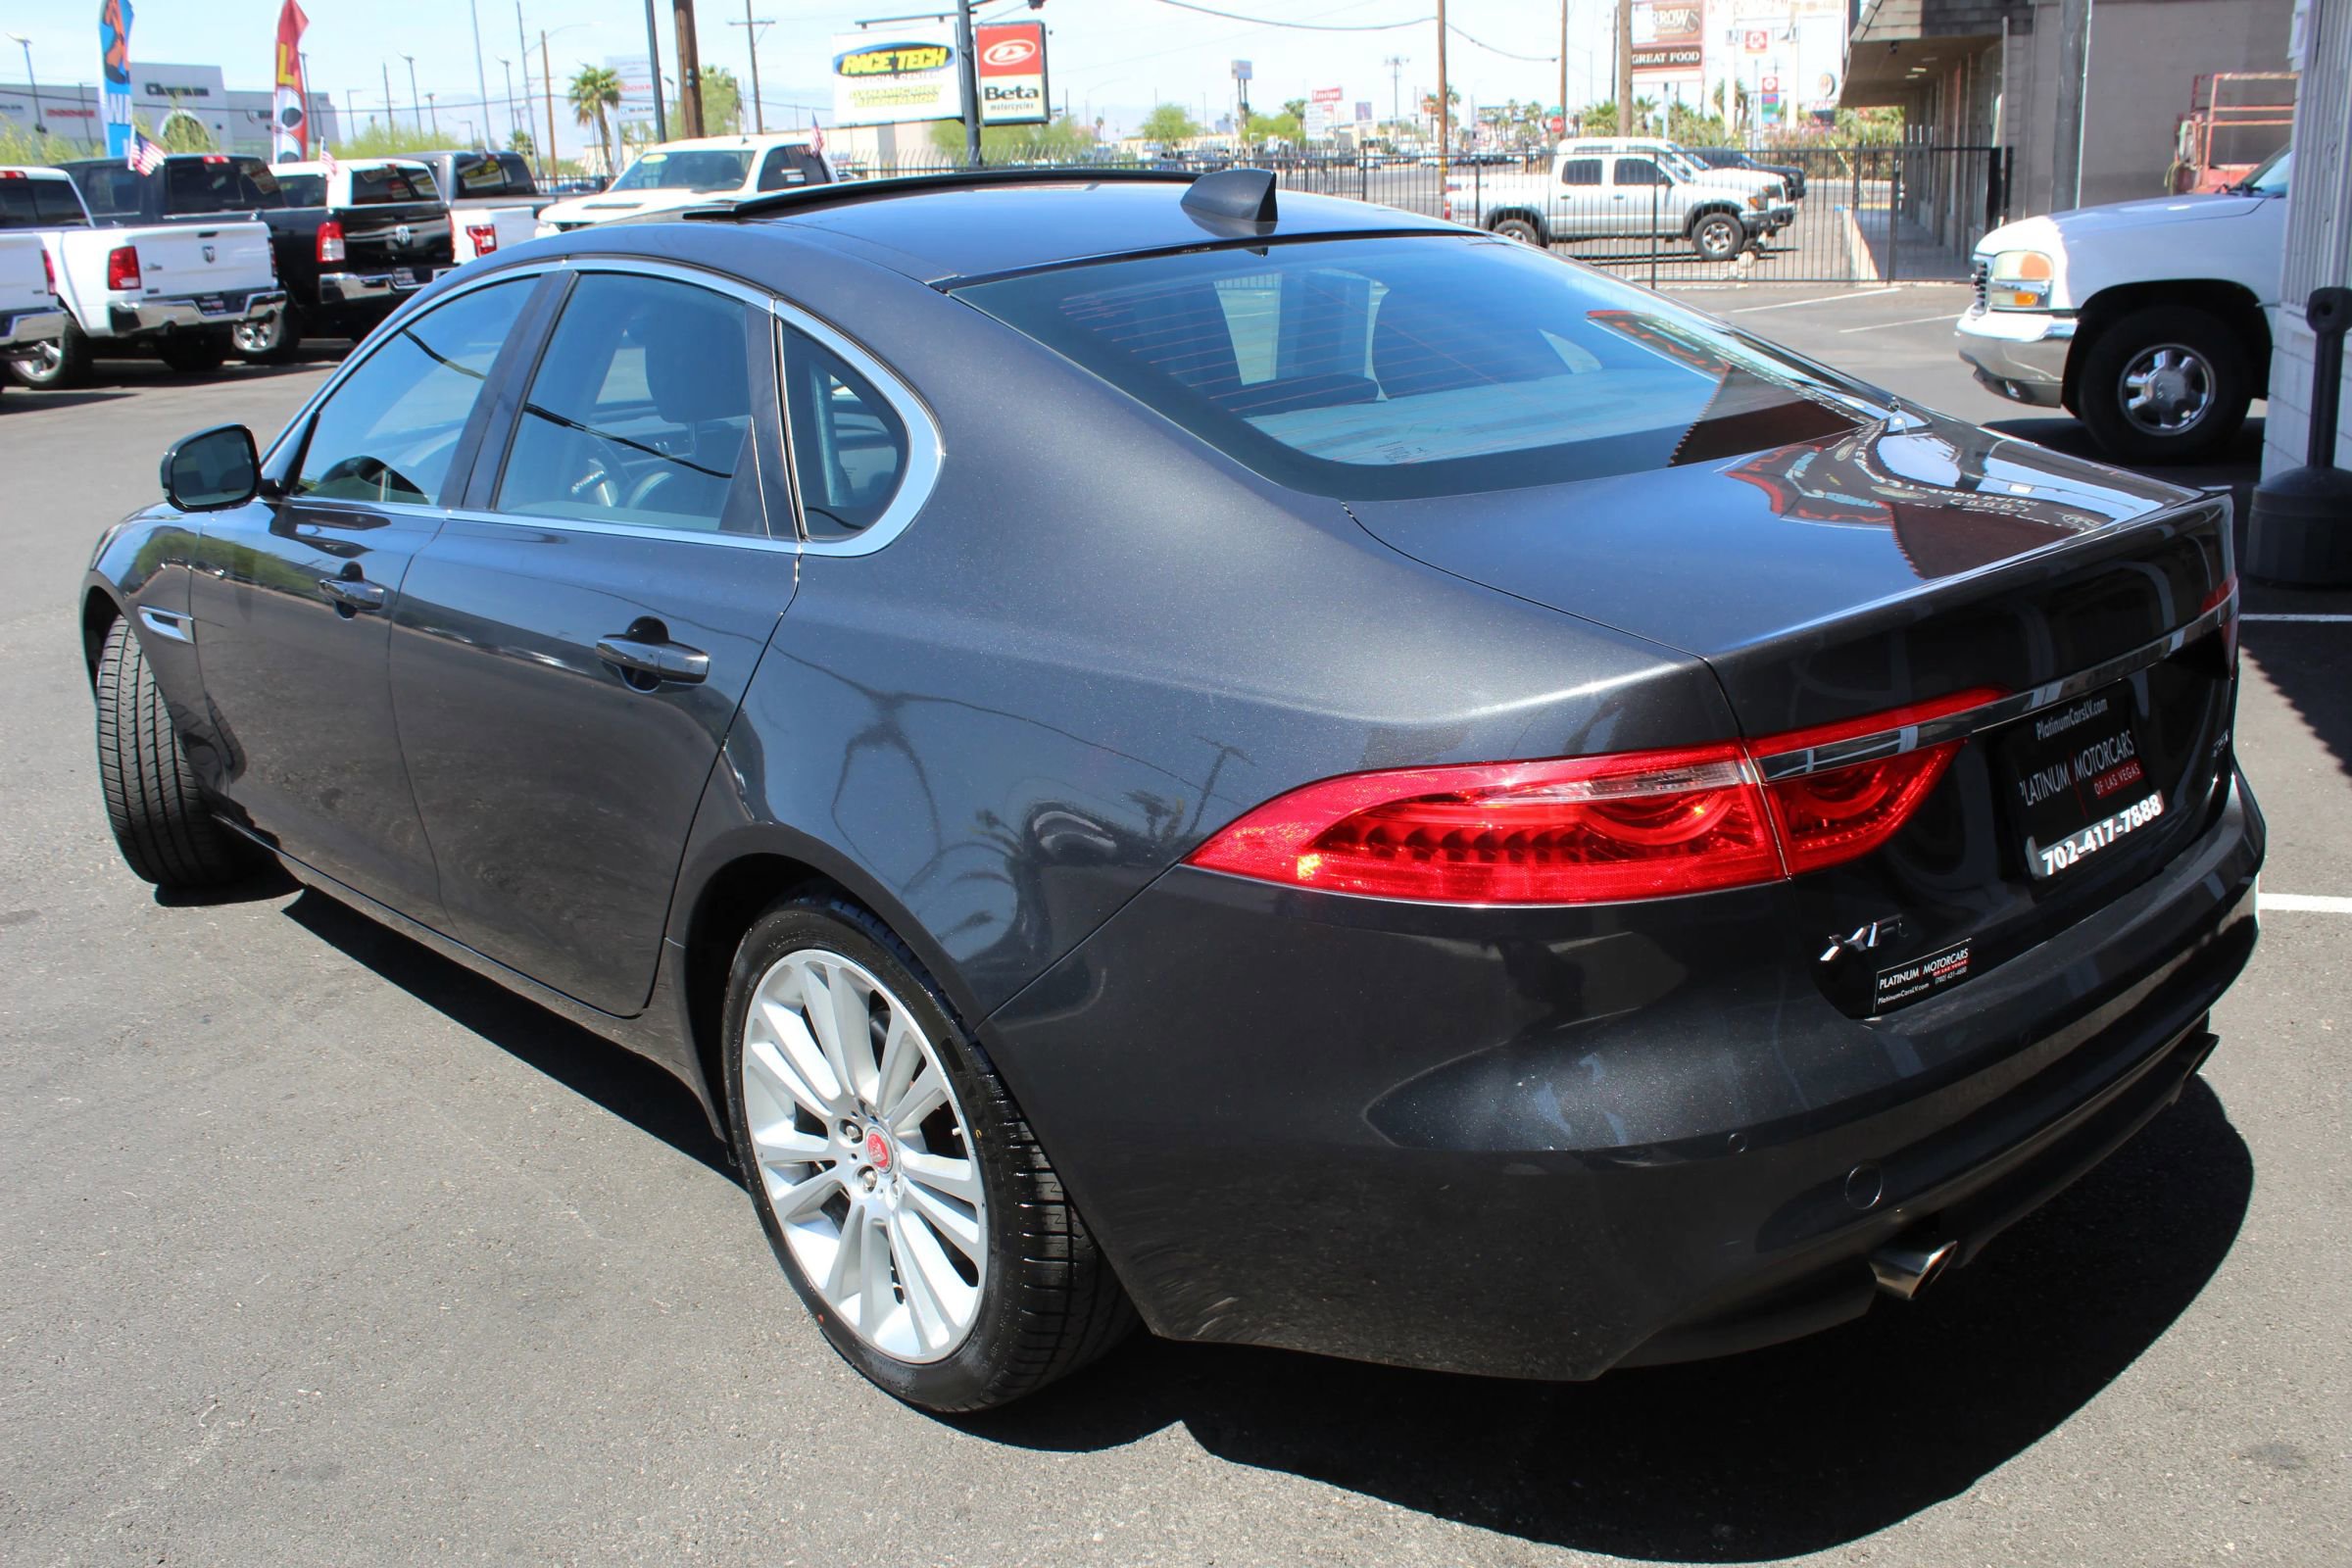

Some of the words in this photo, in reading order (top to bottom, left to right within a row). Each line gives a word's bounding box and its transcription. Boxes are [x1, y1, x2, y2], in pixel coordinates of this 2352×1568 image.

[841, 52, 891, 74] RACE
[896, 47, 947, 71] TECH
[1631, 53, 1667, 65] GREAT
[1669, 51, 1700, 63] FOOD
[984, 85, 1039, 101] Beta
[990, 103, 1034, 113] motorcycles
[2035, 698, 2108, 740] PlatinumCarsLV.com
[2073, 730, 2135, 782] MOTORCARS
[2093, 783, 2103, 796] OF
[2106, 773, 2118, 790] LAS
[2118, 762, 2141, 785] VEGAS
[2041, 794, 2163, 876] 702-417-7888
[1879, 967, 1920, 990] PLATINUM
[1922, 948, 1969, 975] MOTORCARS
[1877, 983, 1930, 1004] PlatinumCarsLV.com
